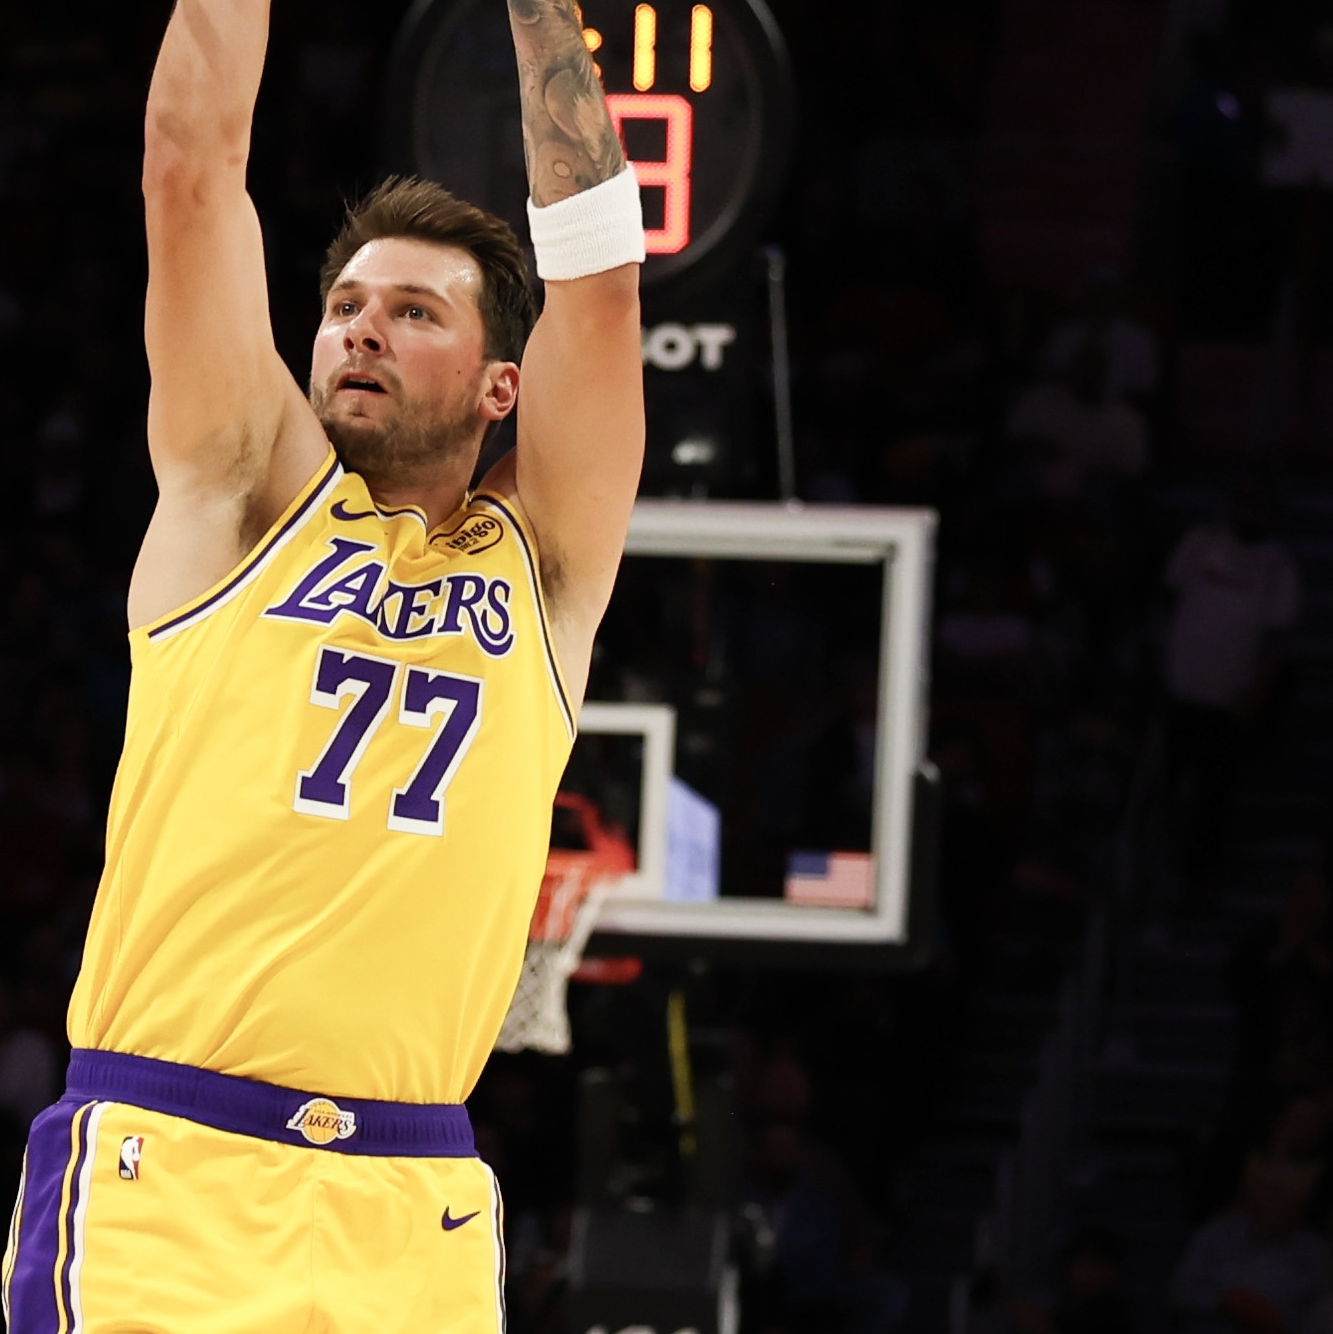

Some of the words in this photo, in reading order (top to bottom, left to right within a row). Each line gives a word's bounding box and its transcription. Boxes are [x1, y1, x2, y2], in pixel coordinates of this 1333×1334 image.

[260, 537, 517, 659] LAKERS
[293, 644, 486, 837] 77
[287, 1106, 356, 1138] LAKERS
